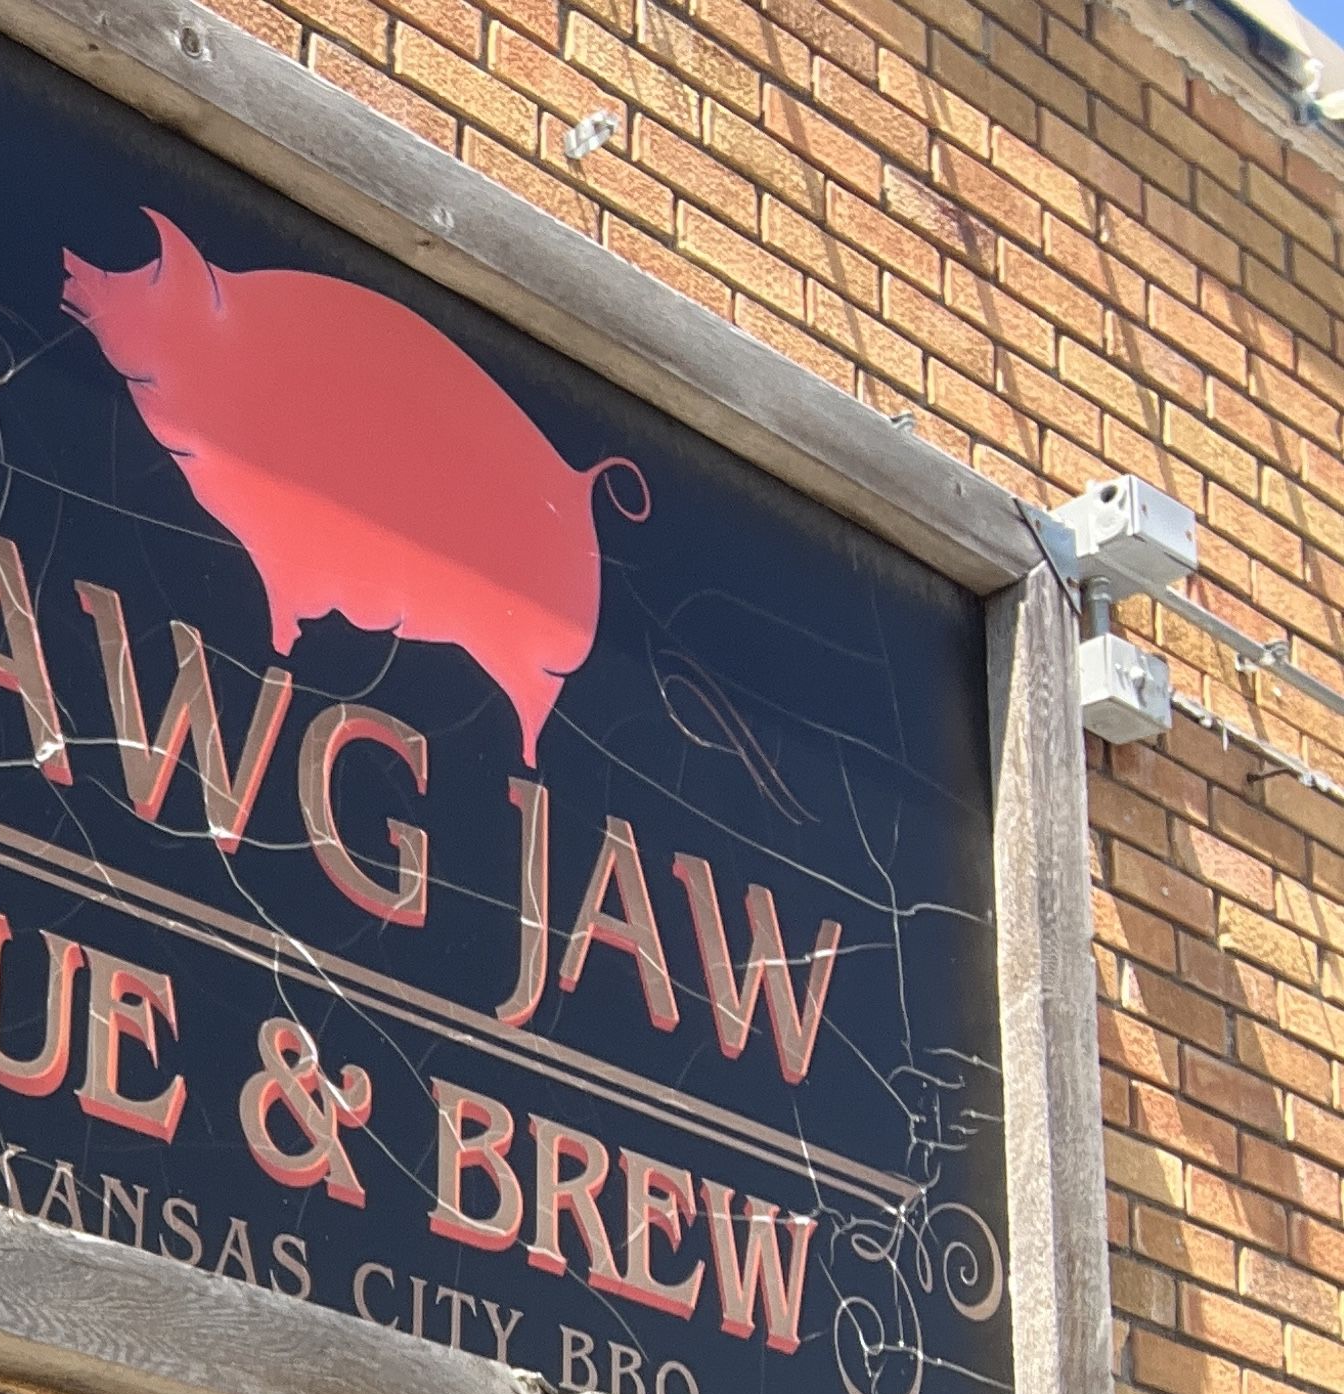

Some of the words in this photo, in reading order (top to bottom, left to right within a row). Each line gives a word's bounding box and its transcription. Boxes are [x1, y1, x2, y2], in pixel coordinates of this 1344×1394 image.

[496, 775, 841, 1083] JAW
[239, 1017, 372, 1209] &
[430, 1077, 819, 1353] BREW
[352, 1262, 524, 1364] CITY
